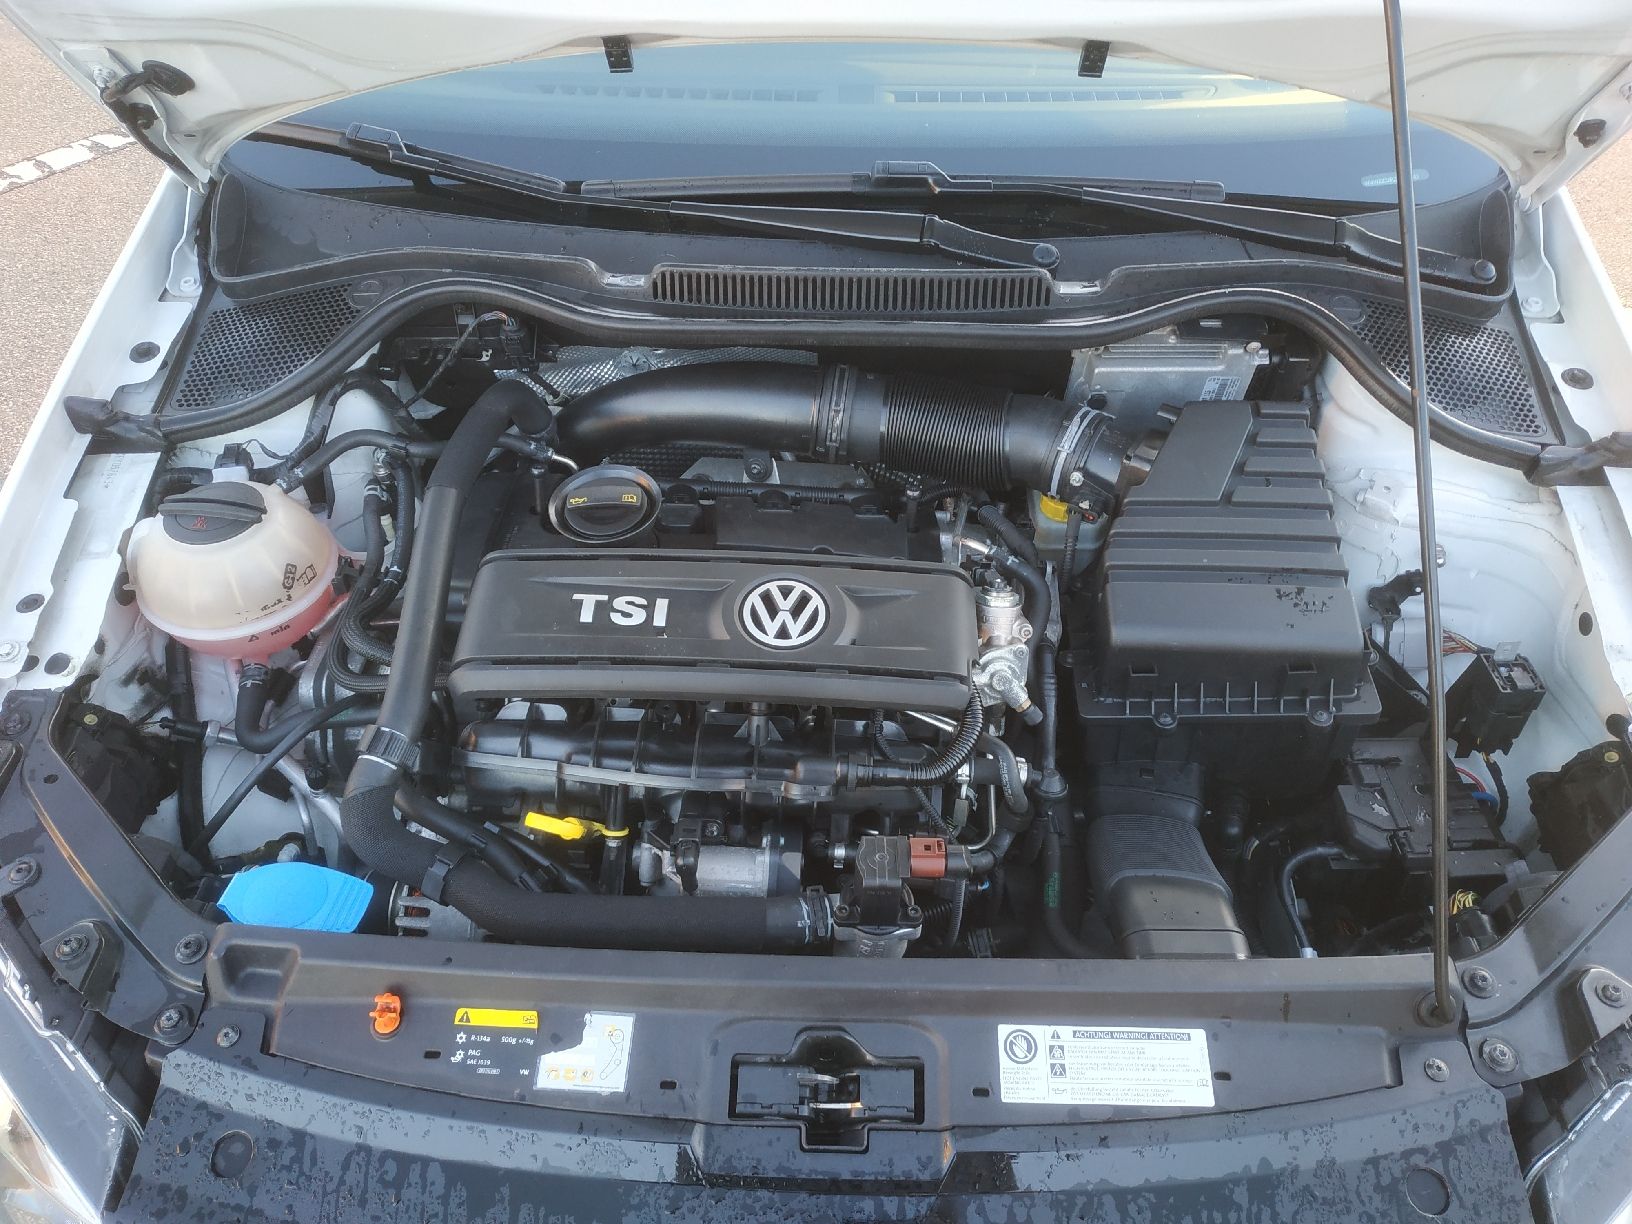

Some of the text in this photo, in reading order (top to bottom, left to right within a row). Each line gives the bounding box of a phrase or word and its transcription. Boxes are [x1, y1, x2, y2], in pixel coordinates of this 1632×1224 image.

[572, 593, 670, 627] TSI
[1112, 1032, 1148, 1040] WARNING!
[1149, 1033, 1189, 1041] ATTENTION!
[519, 1068, 530, 1076] VW
